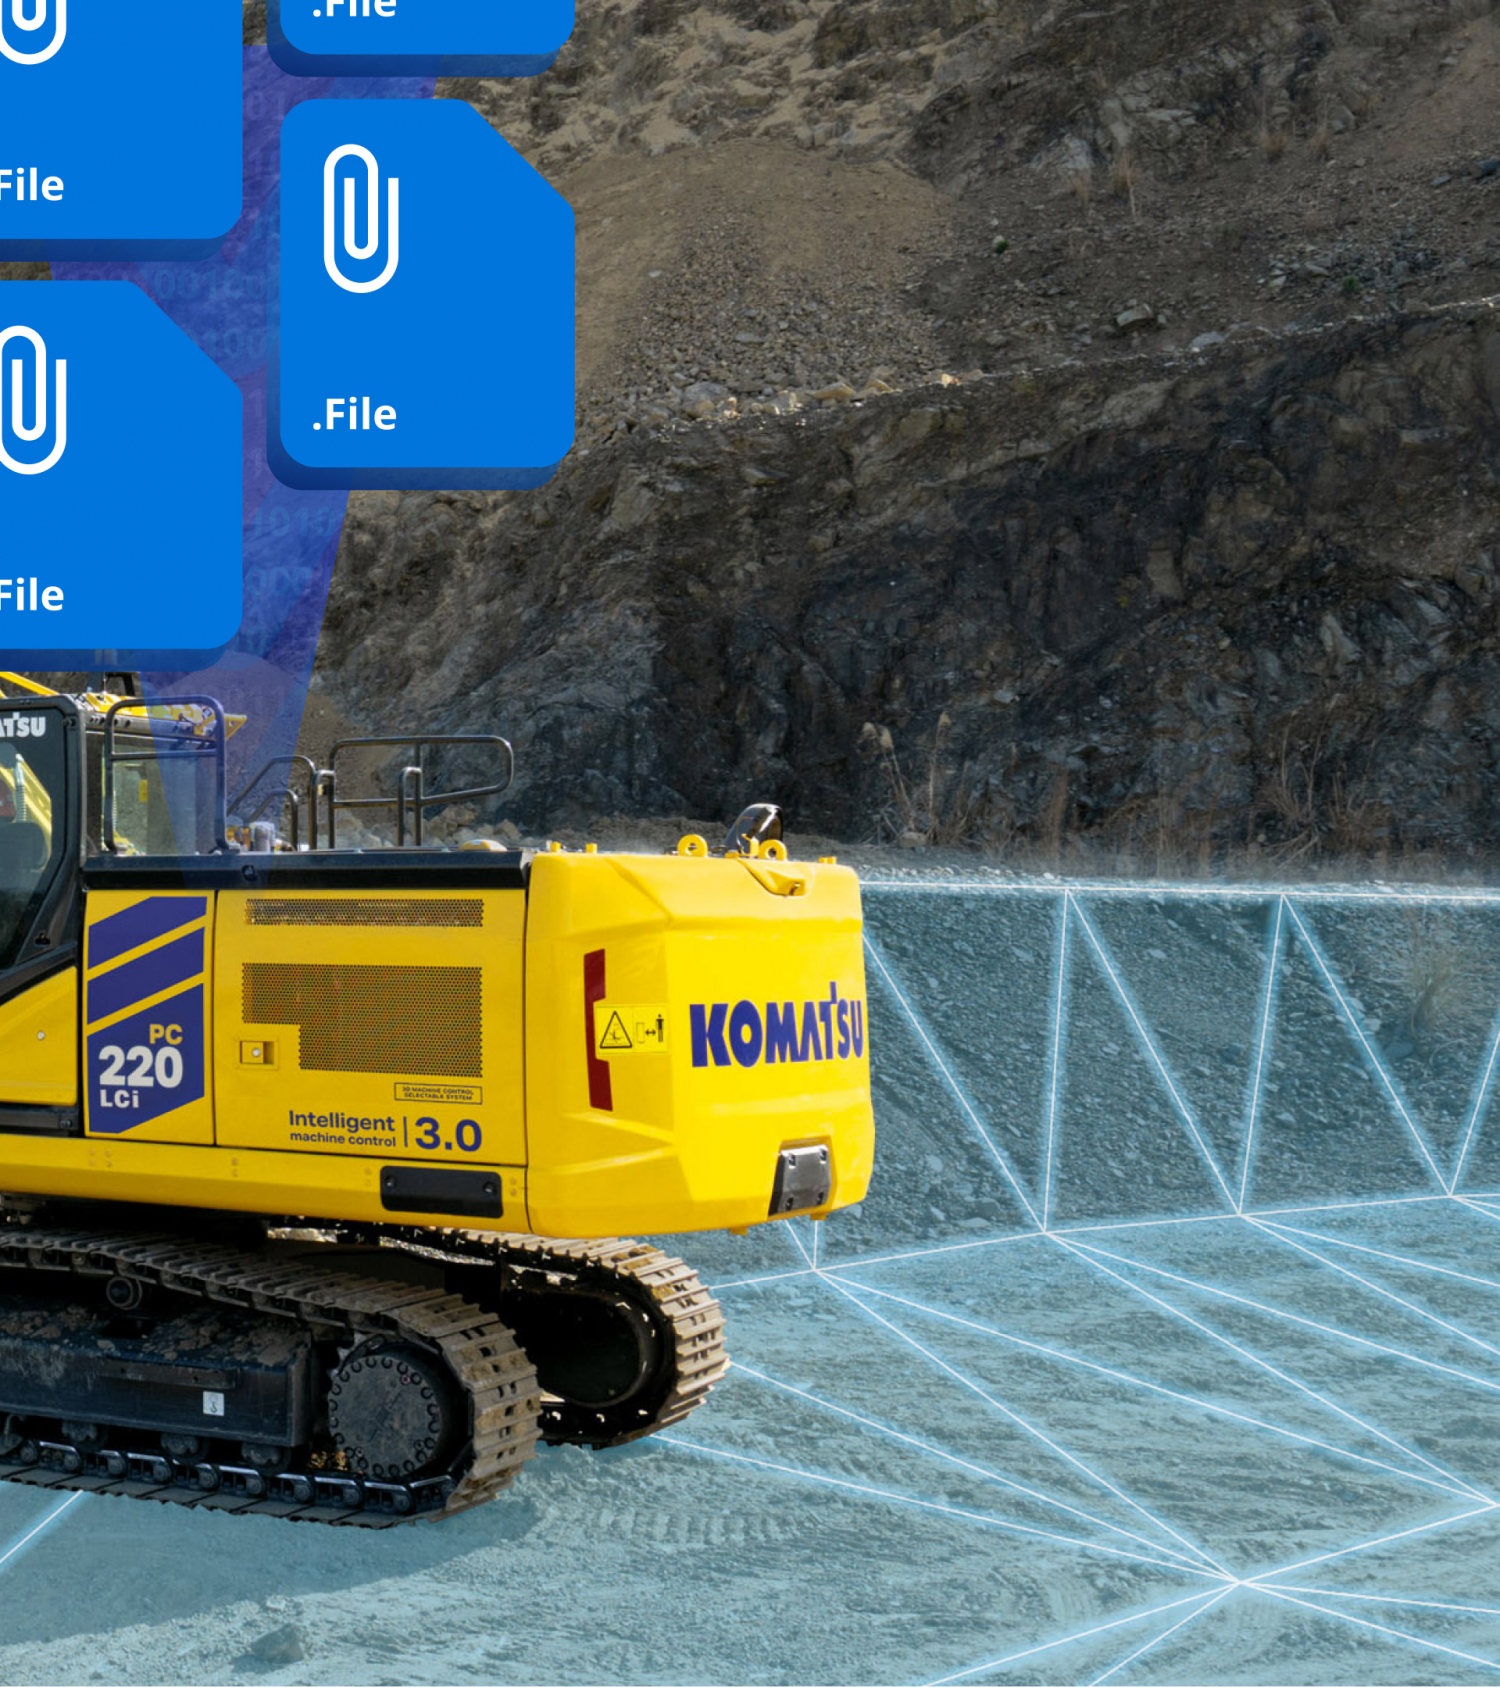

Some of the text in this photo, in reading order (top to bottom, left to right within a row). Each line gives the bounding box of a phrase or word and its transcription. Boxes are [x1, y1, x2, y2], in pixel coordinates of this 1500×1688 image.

[149, 1023, 183, 1045] PC
[689, 981, 864, 1068] KOMATSU
[98, 1045, 183, 1087] 220
[100, 1089, 139, 1108] LCi
[289, 1109, 395, 1134] Intelligent
[415, 1116, 482, 1152] 3.0
[290, 1132, 396, 1147] machine control
